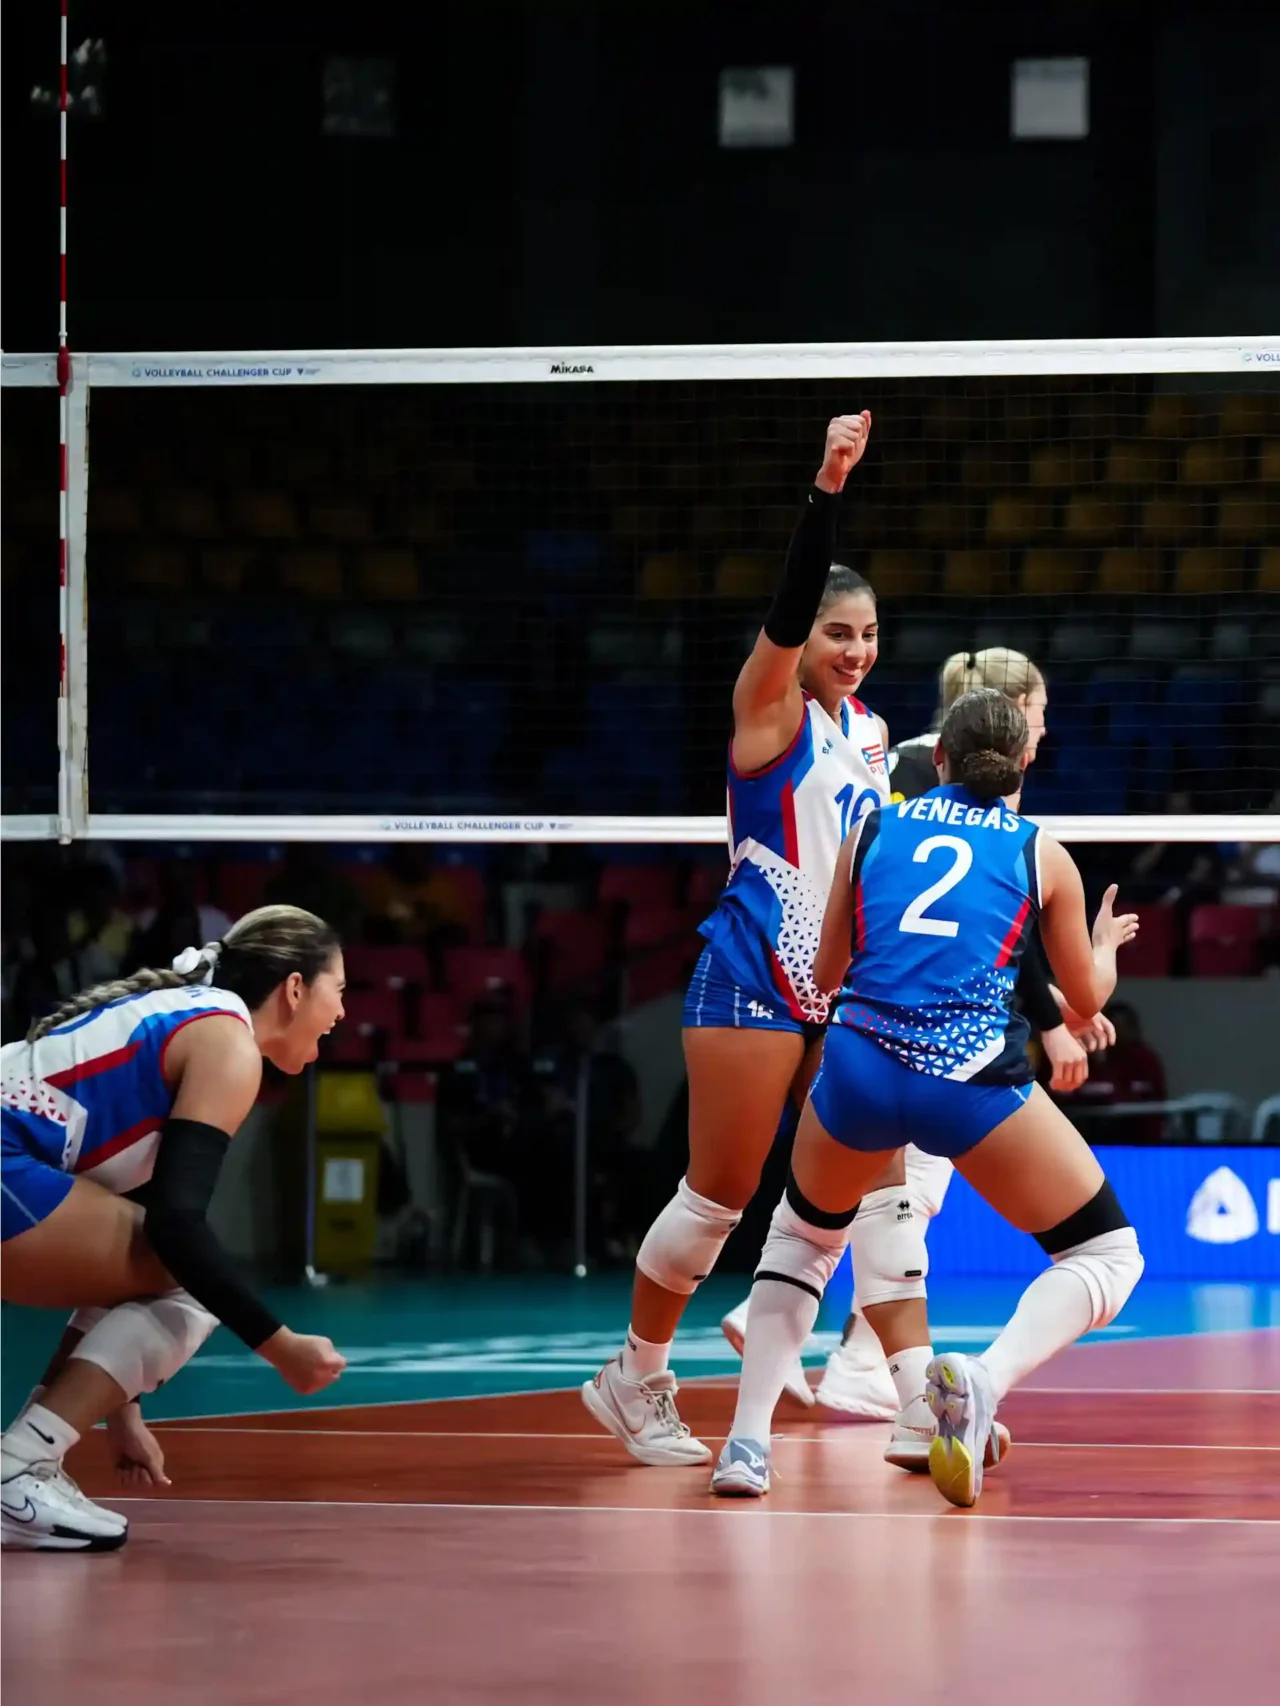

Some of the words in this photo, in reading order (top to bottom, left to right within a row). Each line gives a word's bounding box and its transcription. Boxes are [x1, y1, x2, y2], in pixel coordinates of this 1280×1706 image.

[145, 368, 203, 377] VOLLEYBALL
[206, 368, 269, 377] CHALLENGER
[272, 367, 292, 376] CUP
[394, 821, 453, 830] VOLLEYBALL
[457, 821, 521, 830] CHALLENGER
[524, 821, 544, 830] CUP
[897, 796, 1020, 833] VENEGAS
[899, 835, 973, 938] 2
